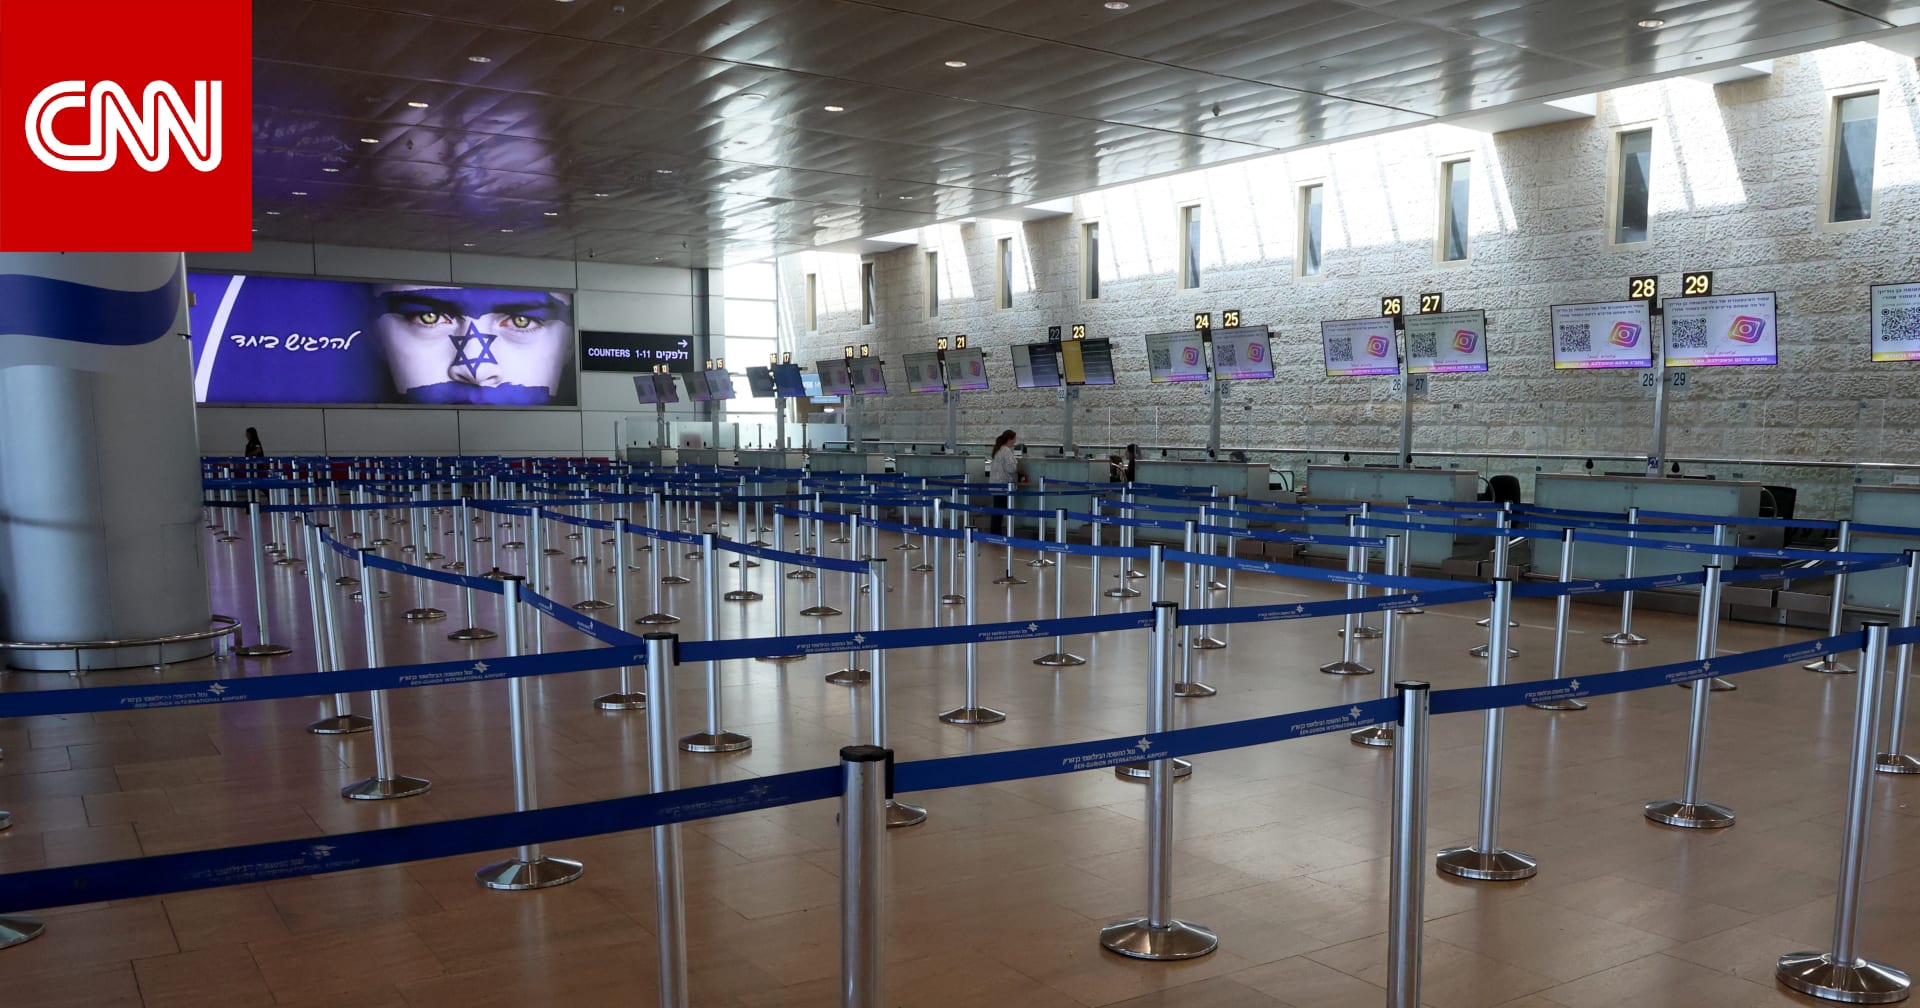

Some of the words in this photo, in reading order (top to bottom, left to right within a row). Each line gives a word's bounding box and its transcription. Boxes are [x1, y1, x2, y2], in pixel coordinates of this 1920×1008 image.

[1632, 279, 1655, 298] 28
[1685, 275, 1709, 294] 29
[1384, 299, 1400, 315] 26
[1422, 296, 1440, 312] 27
[1195, 315, 1209, 329] 24
[1224, 312, 1239, 327] 25
[1050, 328, 1060, 340] 22
[1073, 326, 1085, 339] 23
[230, 334, 279, 350] ביחד
[284, 330, 361, 351] להרגיש
[938, 338, 947, 350] 20
[956, 336, 965, 348] 21
[588, 348, 631, 358] COUNTERS
[635, 350, 651, 359] 1-11
[656, 349, 689, 361] דלפקים
[845, 346, 853, 358] 18
[861, 345, 868, 357] 19
[1392, 378, 1402, 391] 26
[1416, 378, 1425, 391] 27
[1642, 373, 1654, 387] 28
[1673, 372, 1686, 386] 29
[1107, 754, 1146, 766] INTERNATIONAL
[1146, 751, 1168, 760] AIRPORT
